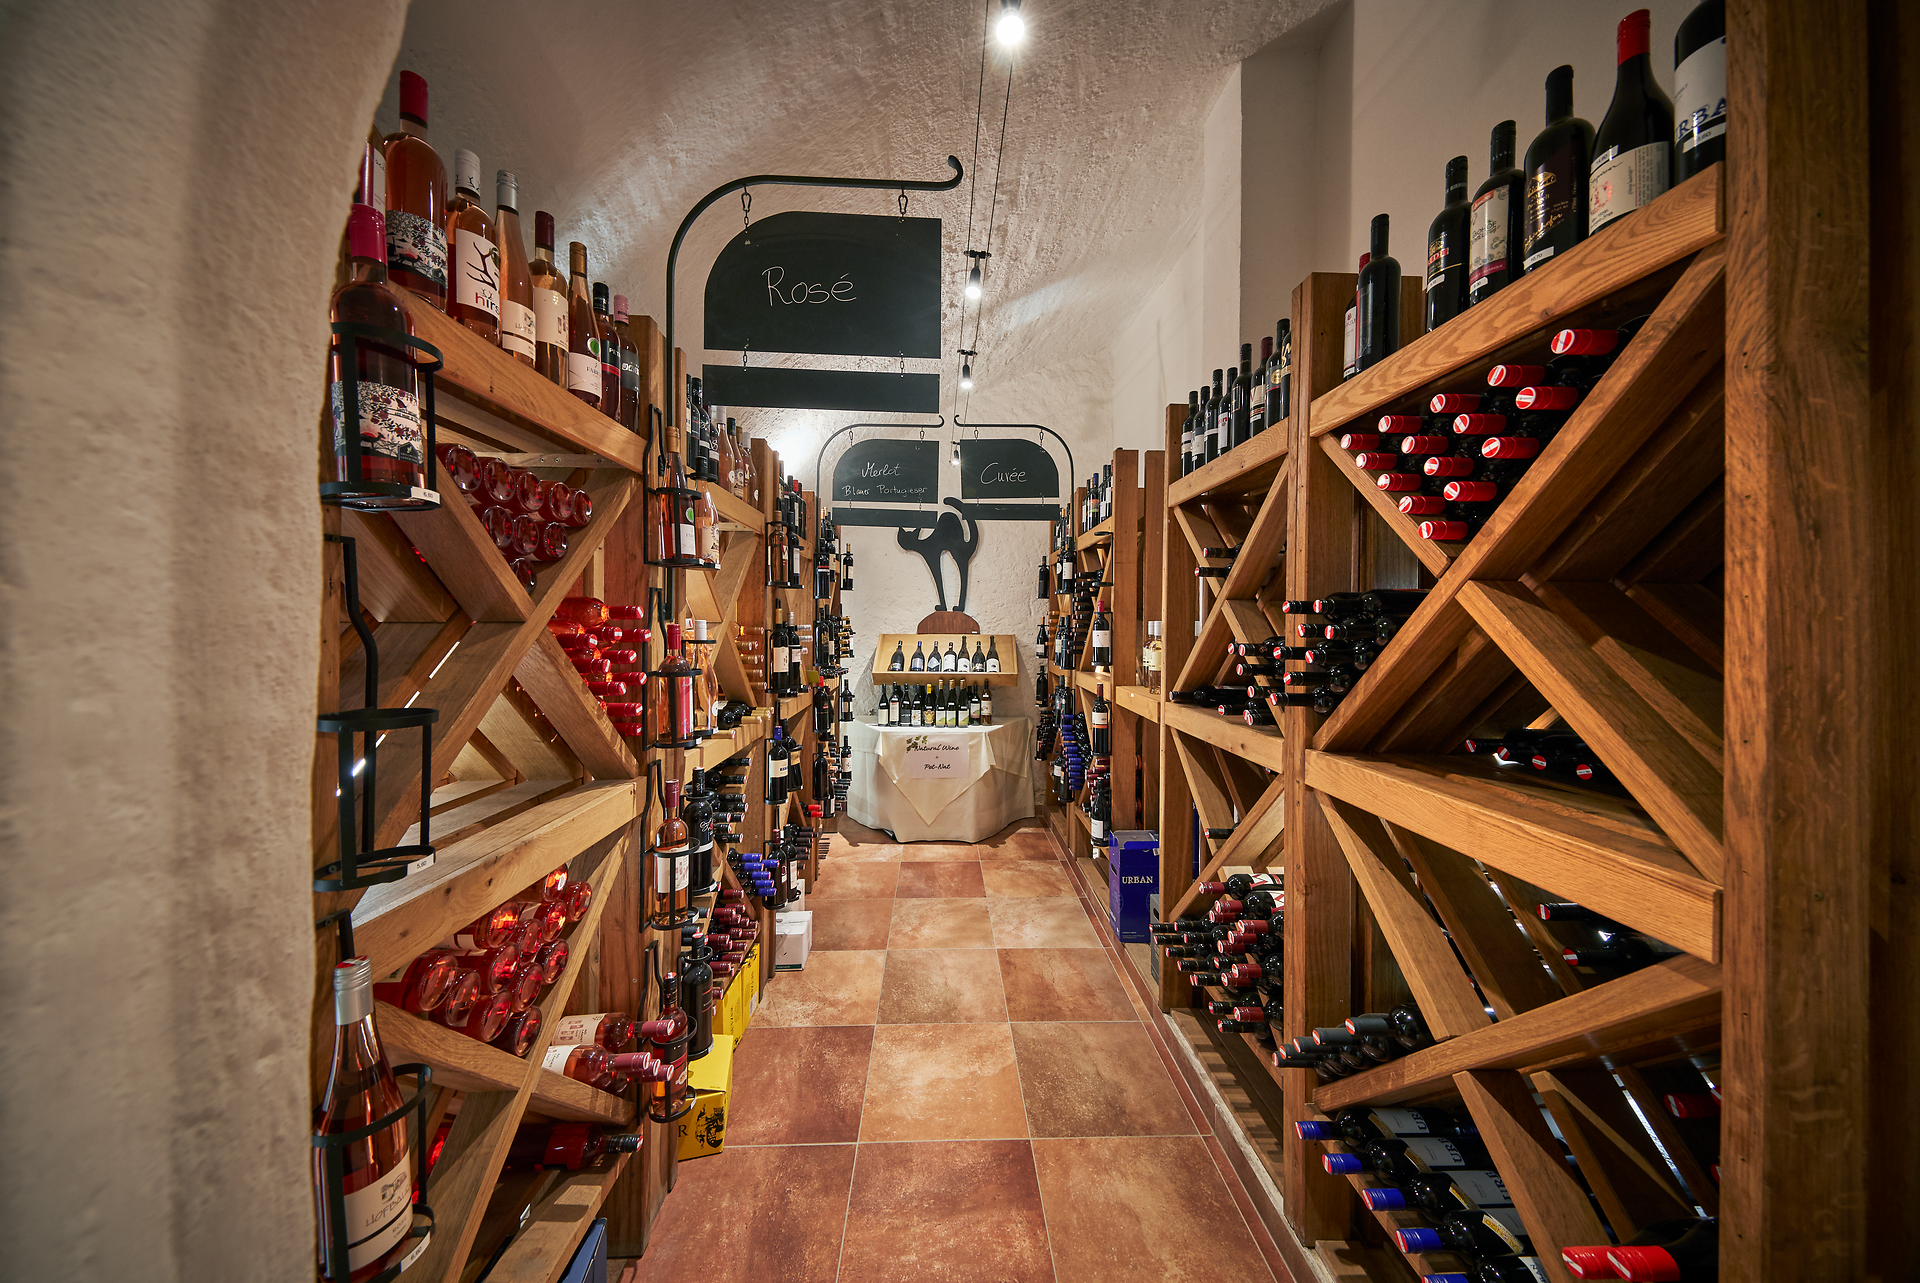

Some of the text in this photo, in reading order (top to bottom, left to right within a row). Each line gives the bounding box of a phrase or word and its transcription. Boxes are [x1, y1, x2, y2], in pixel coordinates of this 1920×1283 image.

[761, 265, 857, 307] Rosé
[861, 461, 901, 478] Merlot
[979, 461, 1028, 485] Cuvée
[841, 484, 928, 498] Blauer Portugieser
[914, 743, 941, 752] Natural
[1121, 875, 1154, 885] URBAN
